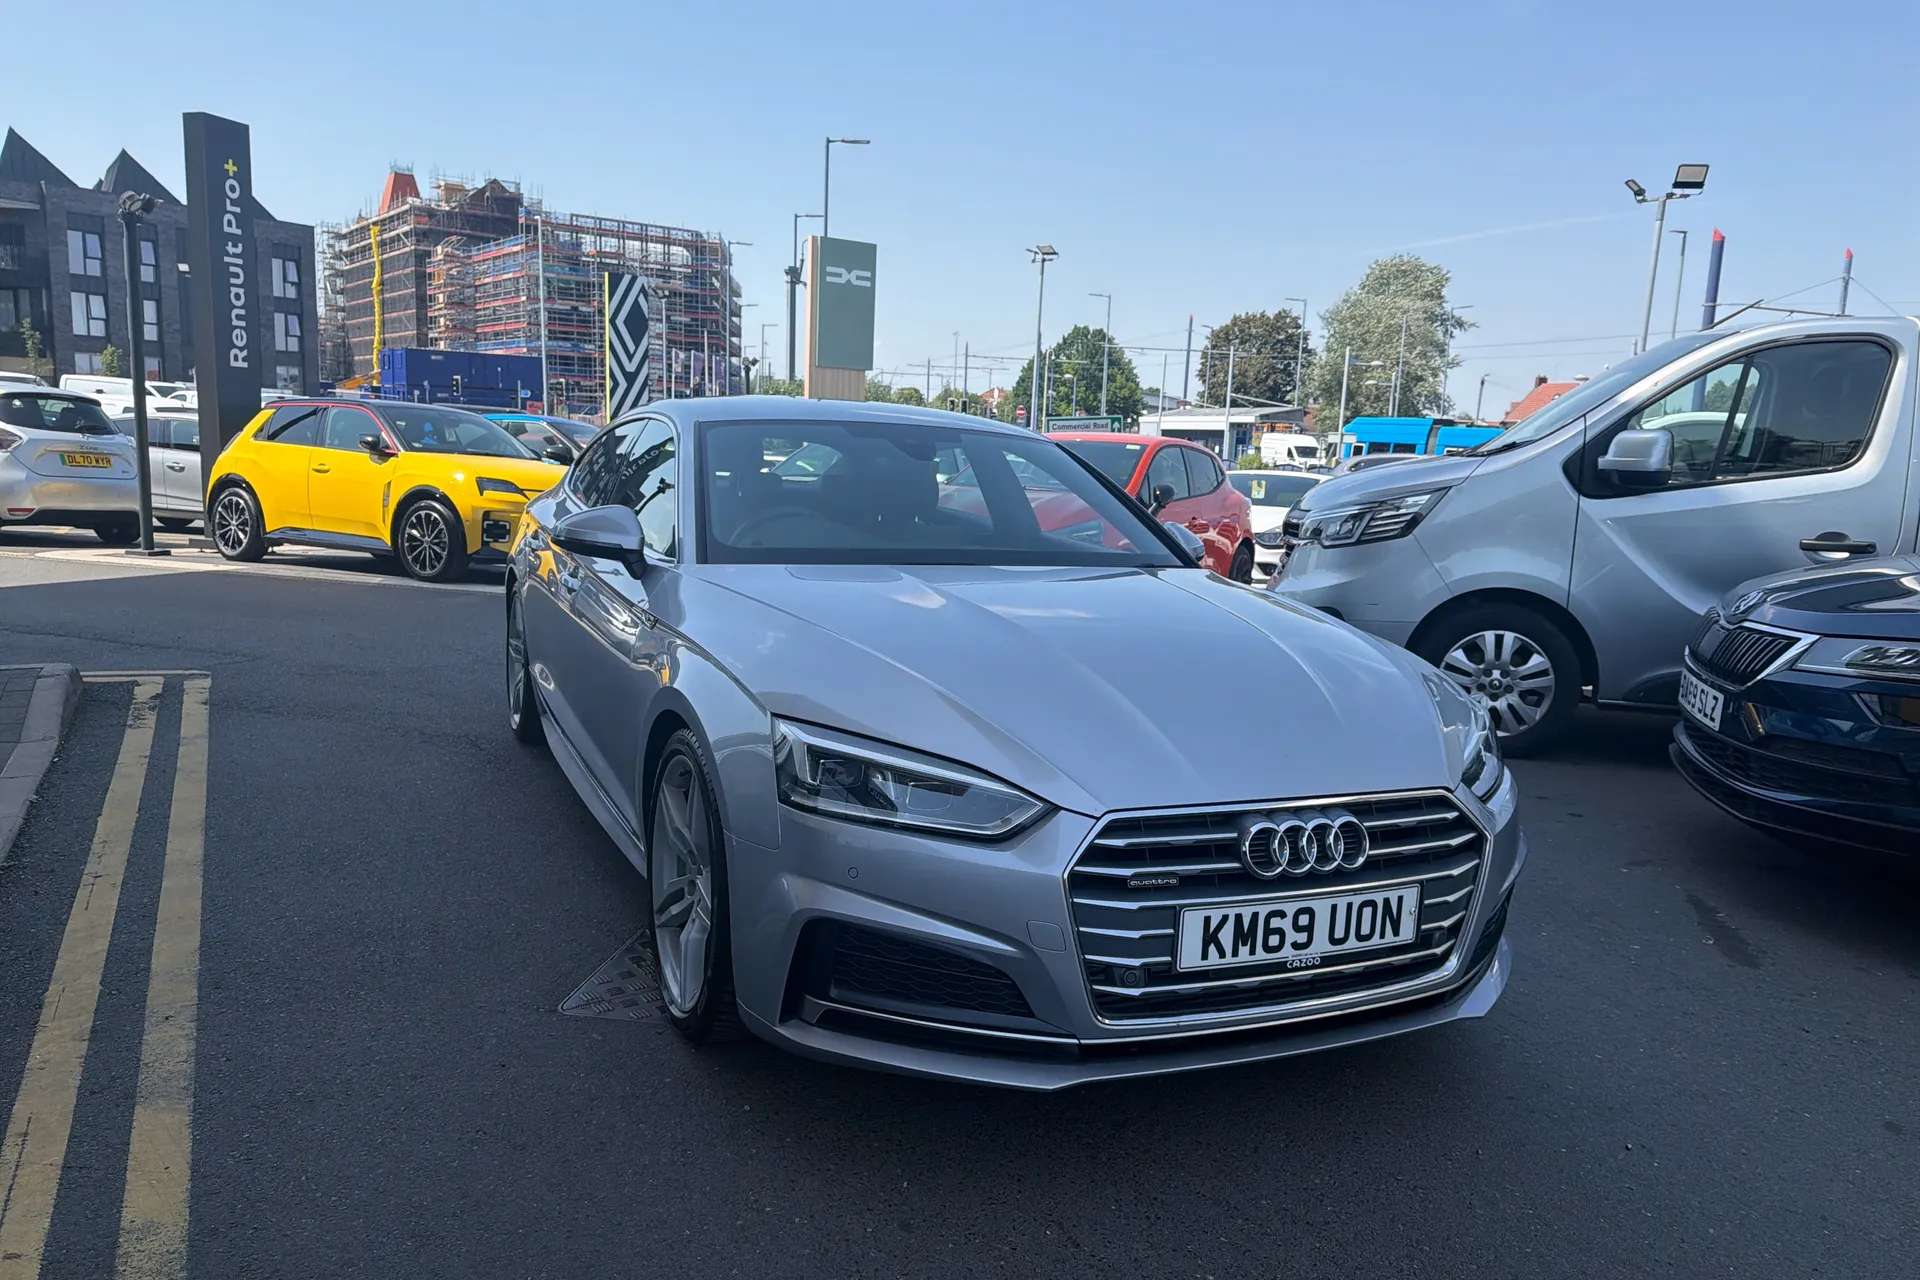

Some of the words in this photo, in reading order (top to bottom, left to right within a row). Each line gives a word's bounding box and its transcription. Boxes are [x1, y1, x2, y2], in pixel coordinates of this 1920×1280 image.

[223, 241, 249, 368] Renault
[1052, 422, 1091, 431] Commercial
[1093, 422, 1108, 430] Road
[66, 454, 92, 465] DL70
[1698, 688, 1719, 722] SLZ
[1129, 879, 1177, 888] quattro
[1200, 907, 1316, 961] KM69
[1328, 895, 1404, 946] UON
[1286, 957, 1320, 968] CAZOO
